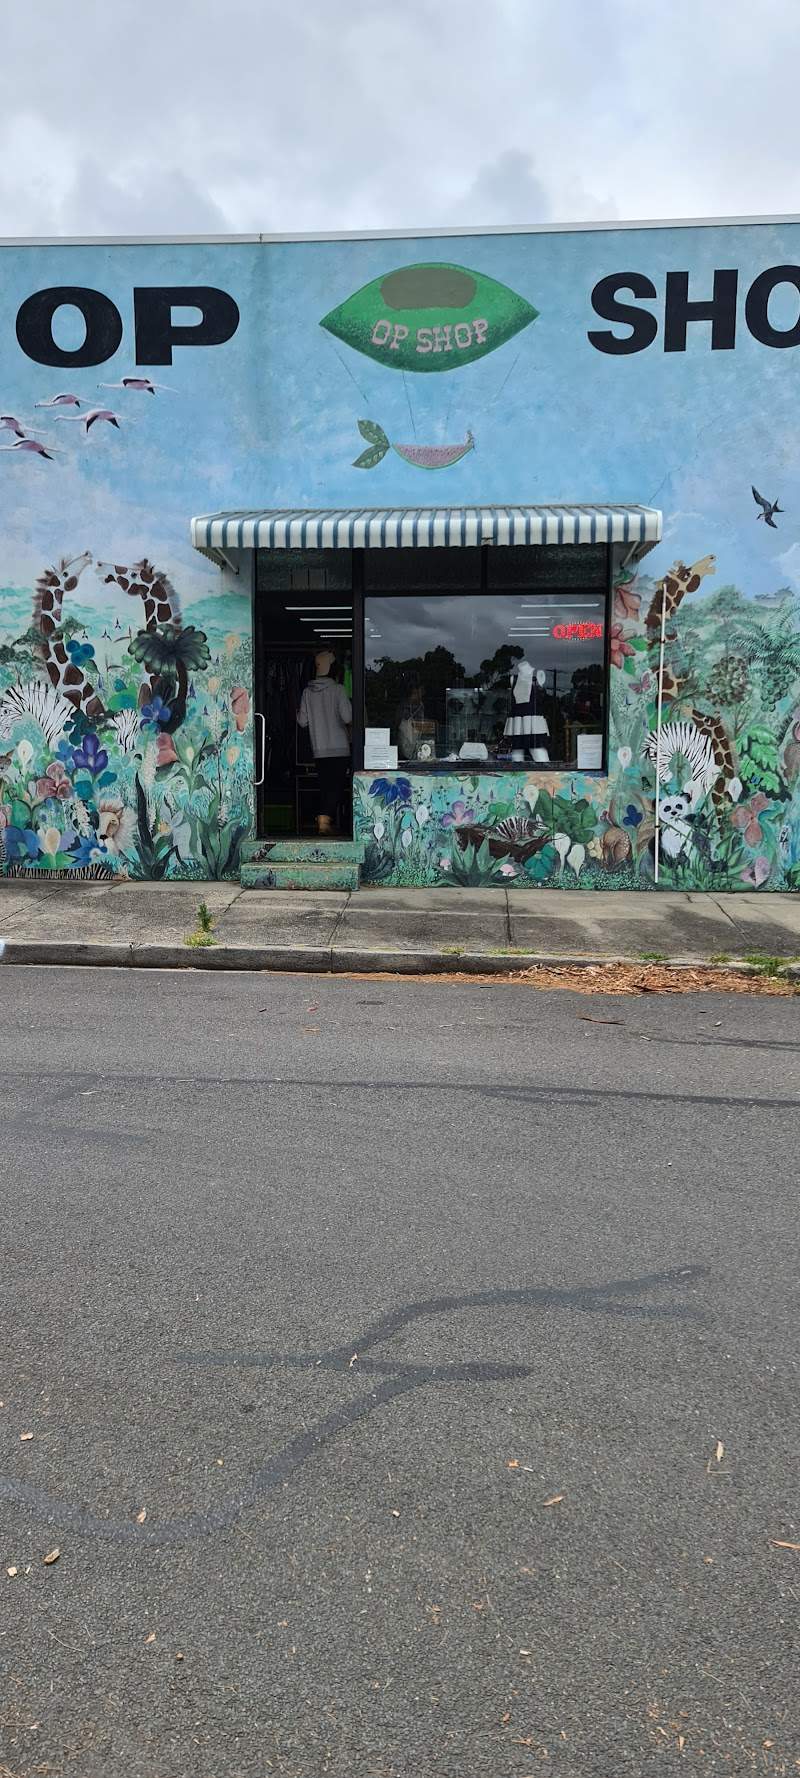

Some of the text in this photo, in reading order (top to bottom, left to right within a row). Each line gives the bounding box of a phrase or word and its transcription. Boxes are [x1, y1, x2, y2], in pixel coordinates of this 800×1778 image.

[15, 286, 240, 368] OP
[371, 319, 489, 353] OP SHOP
[552, 623, 603, 640] OPEN
